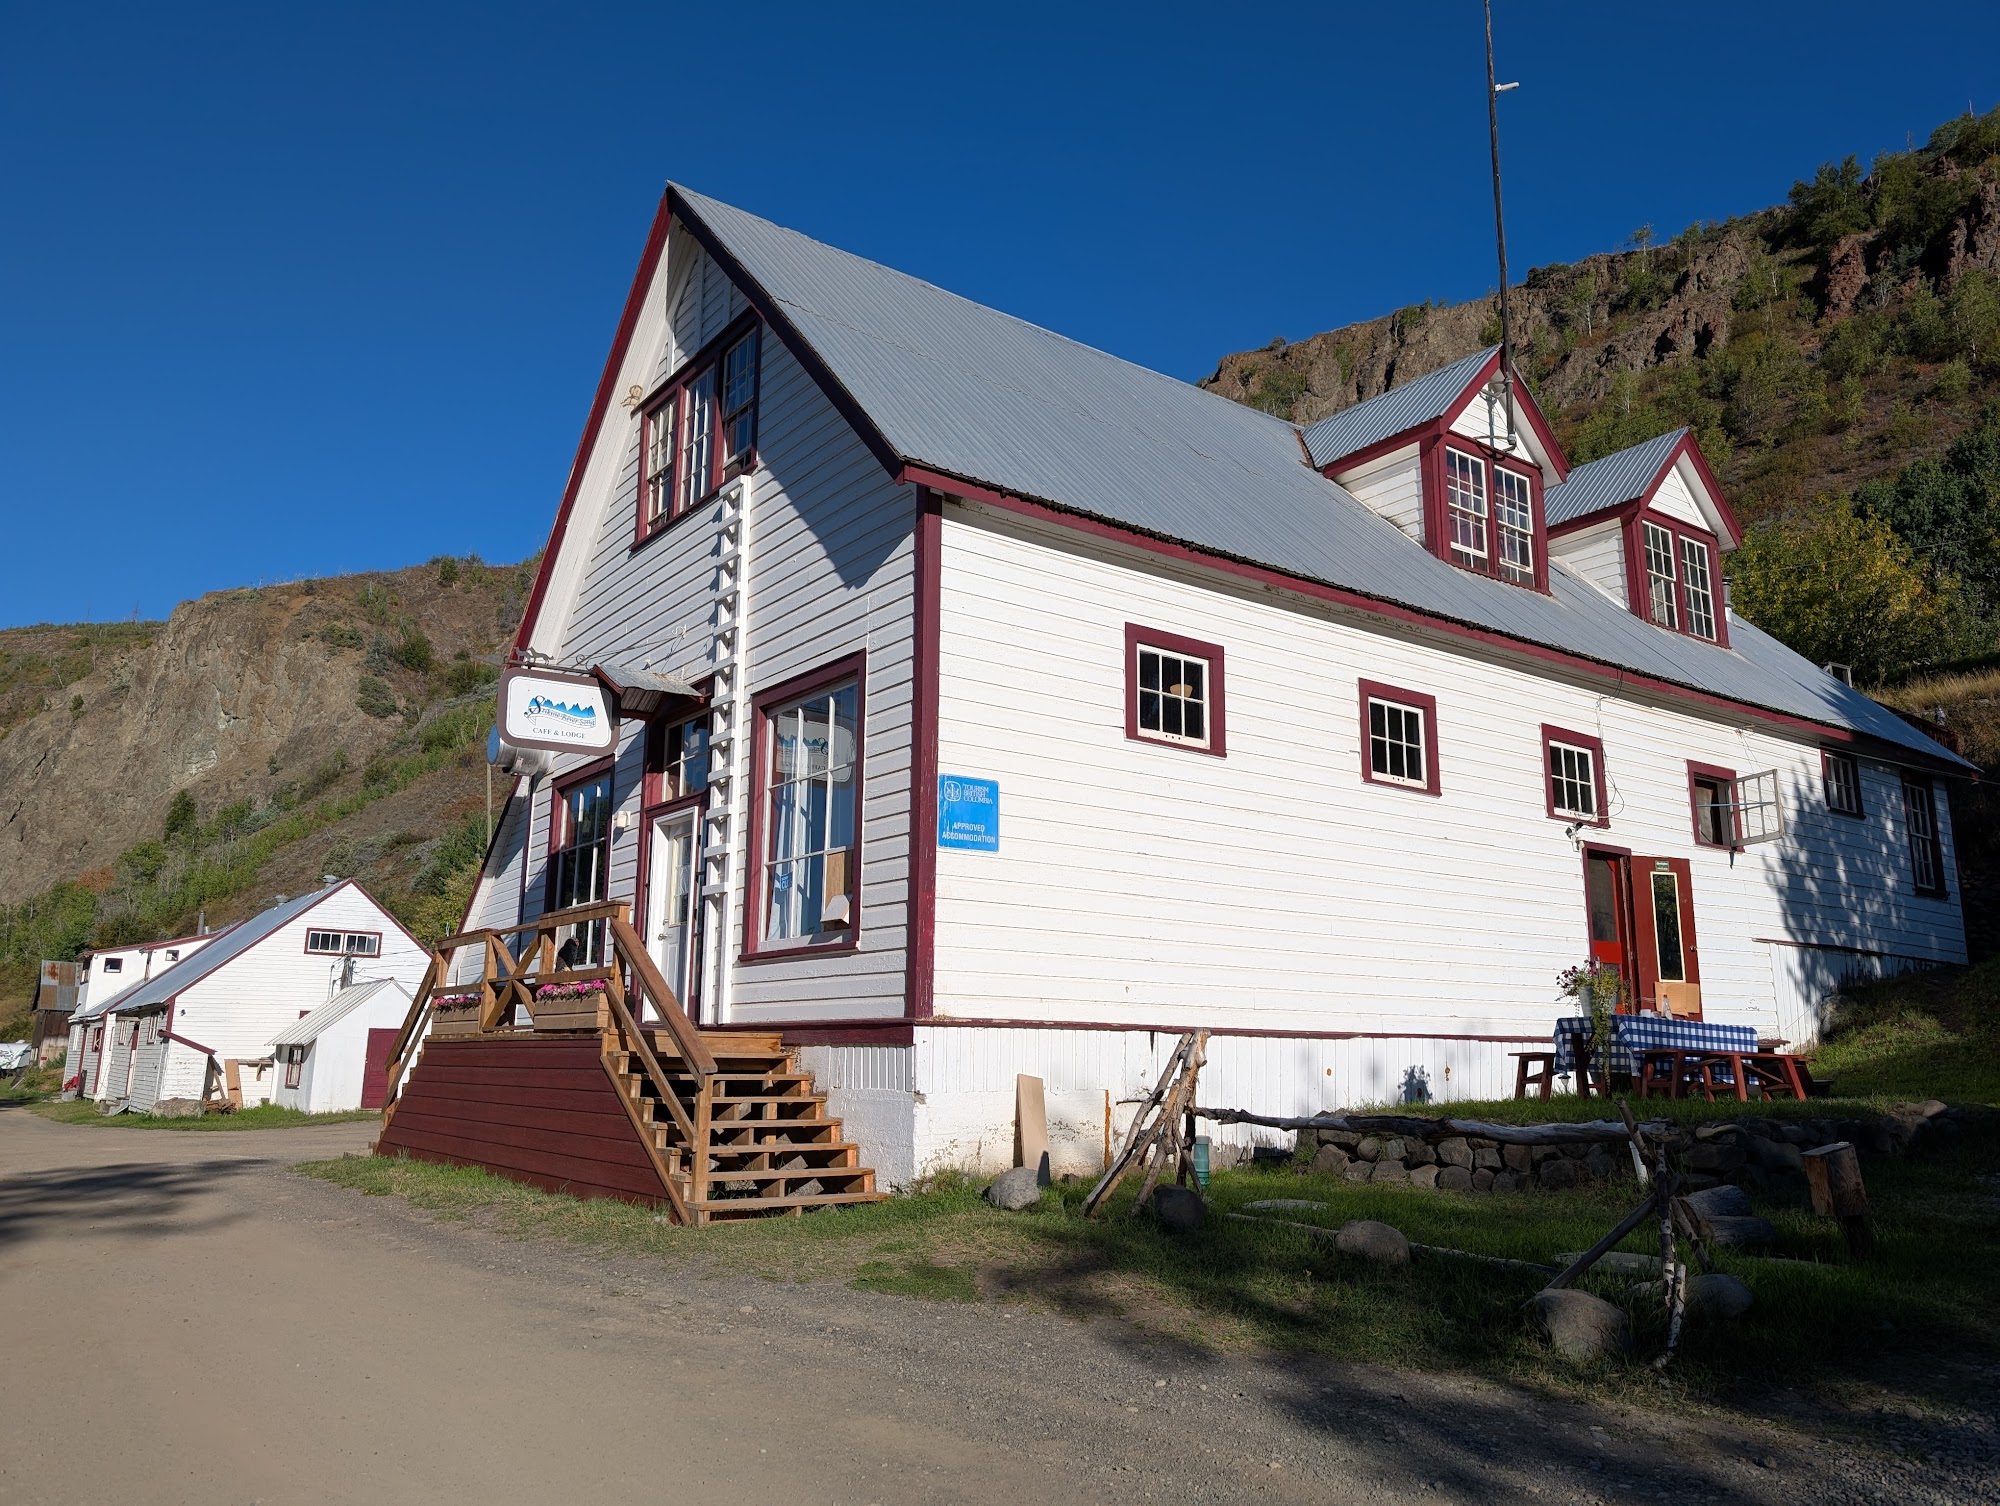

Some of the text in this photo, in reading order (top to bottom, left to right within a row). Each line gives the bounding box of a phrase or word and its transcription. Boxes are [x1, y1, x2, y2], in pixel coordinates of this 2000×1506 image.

[561, 731, 586, 739] LODGE
[963, 784, 989, 792] TOURISM
[964, 796, 993, 804] COLUMBIA
[953, 822, 985, 831] APPROVED
[942, 831, 996, 843] ACCOMMODATION
